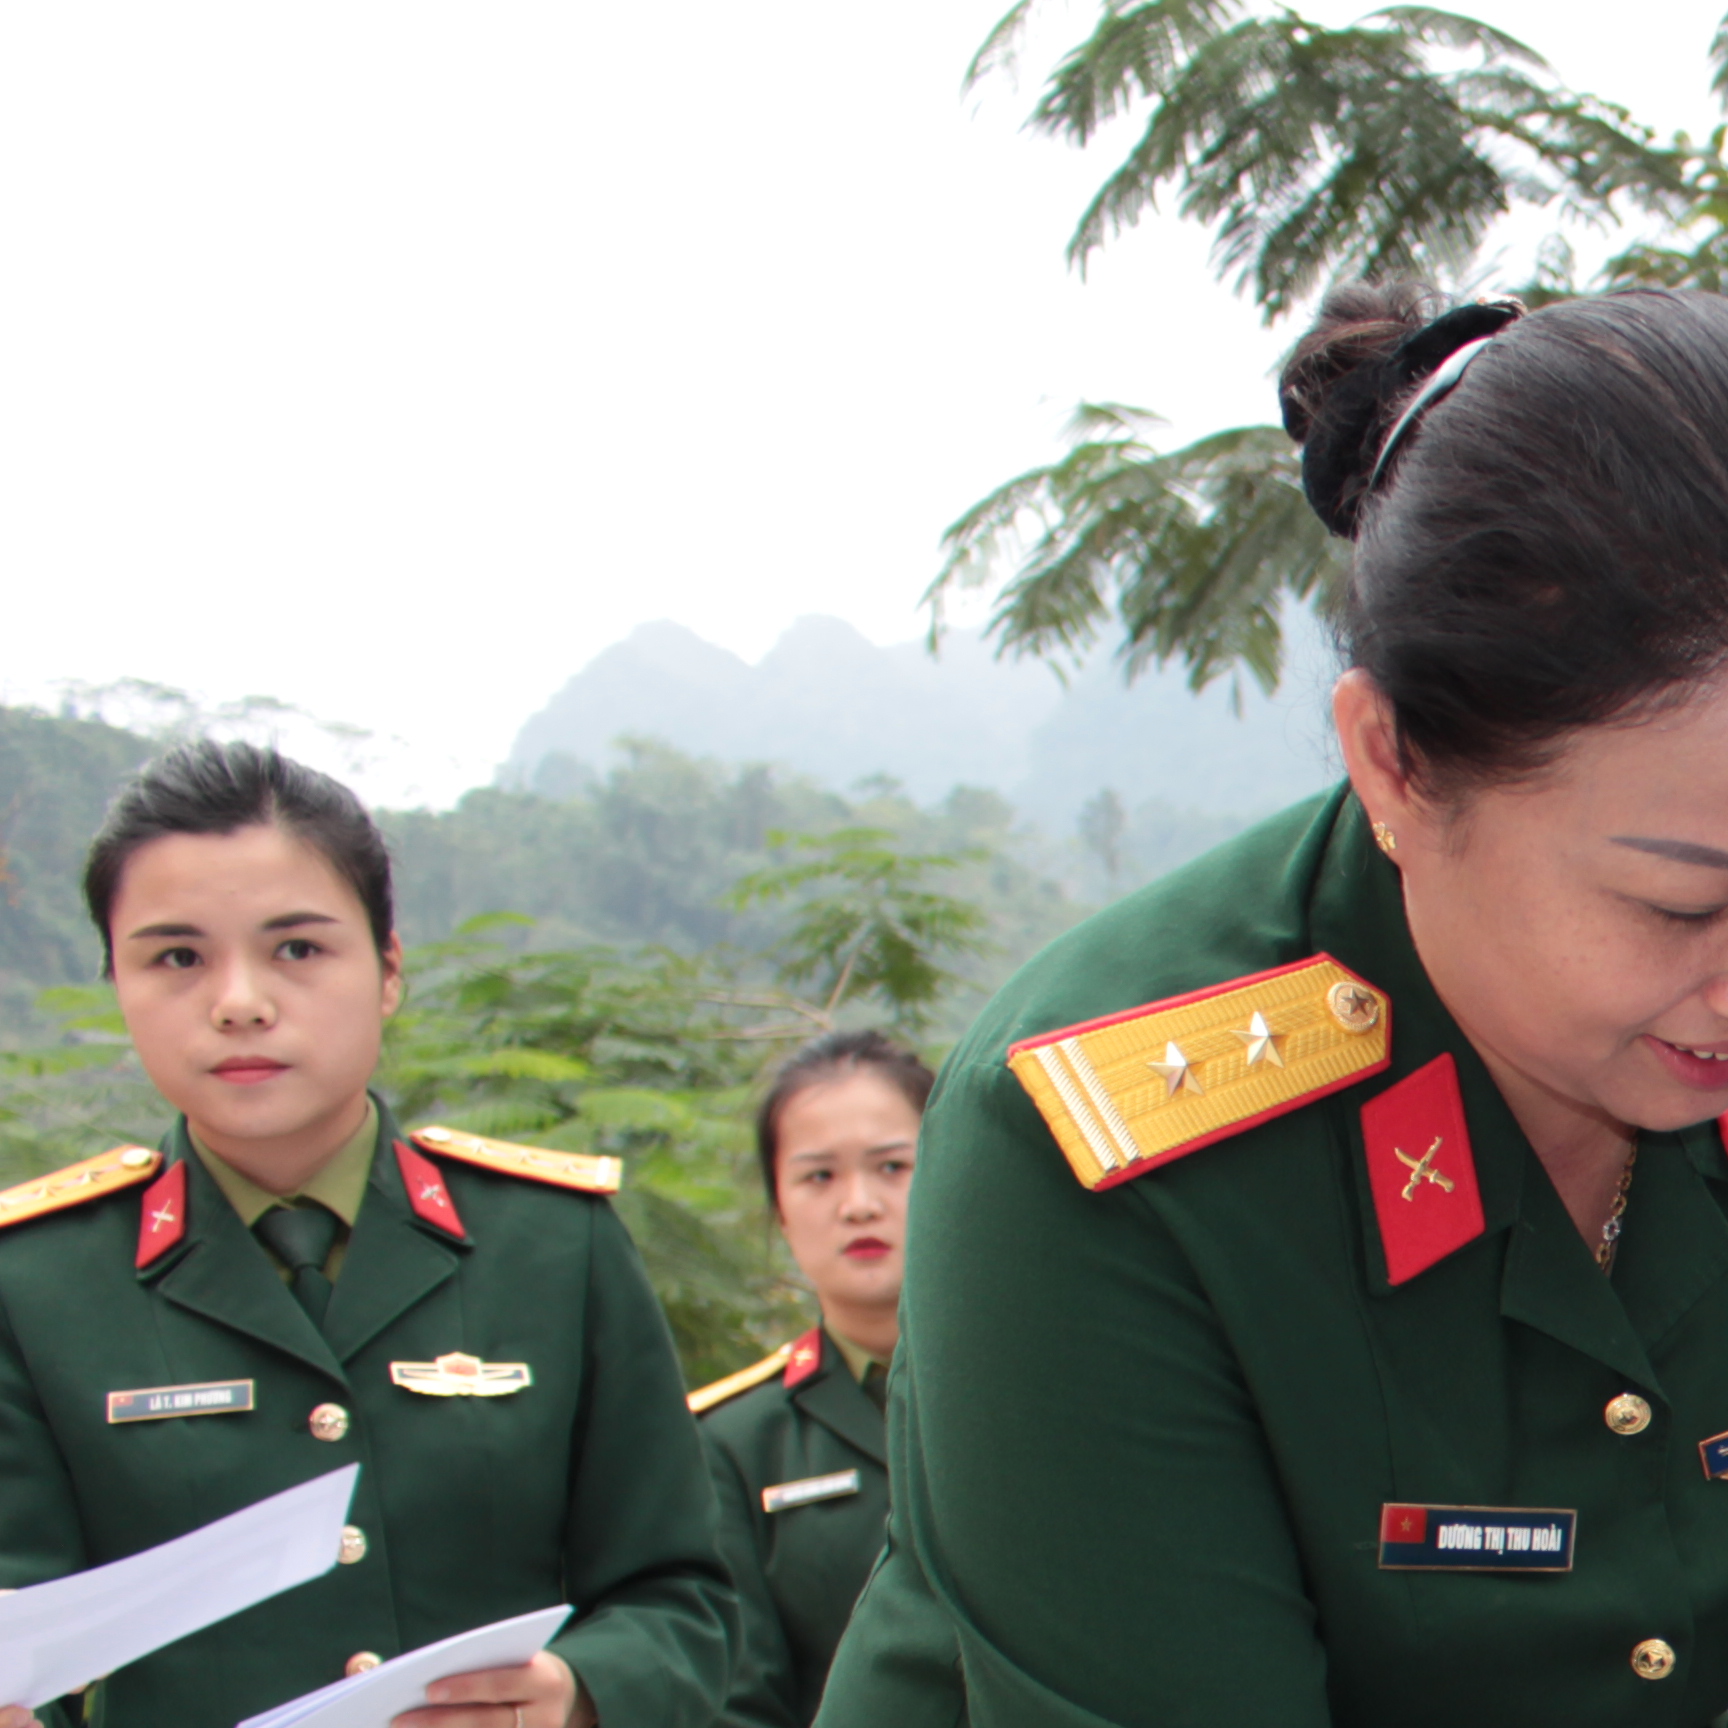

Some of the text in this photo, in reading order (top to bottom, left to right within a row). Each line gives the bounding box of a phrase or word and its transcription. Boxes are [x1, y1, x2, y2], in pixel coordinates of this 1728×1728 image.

[1438, 1523, 1562, 1555] DƯƠNG THỊ THU HOÀI
